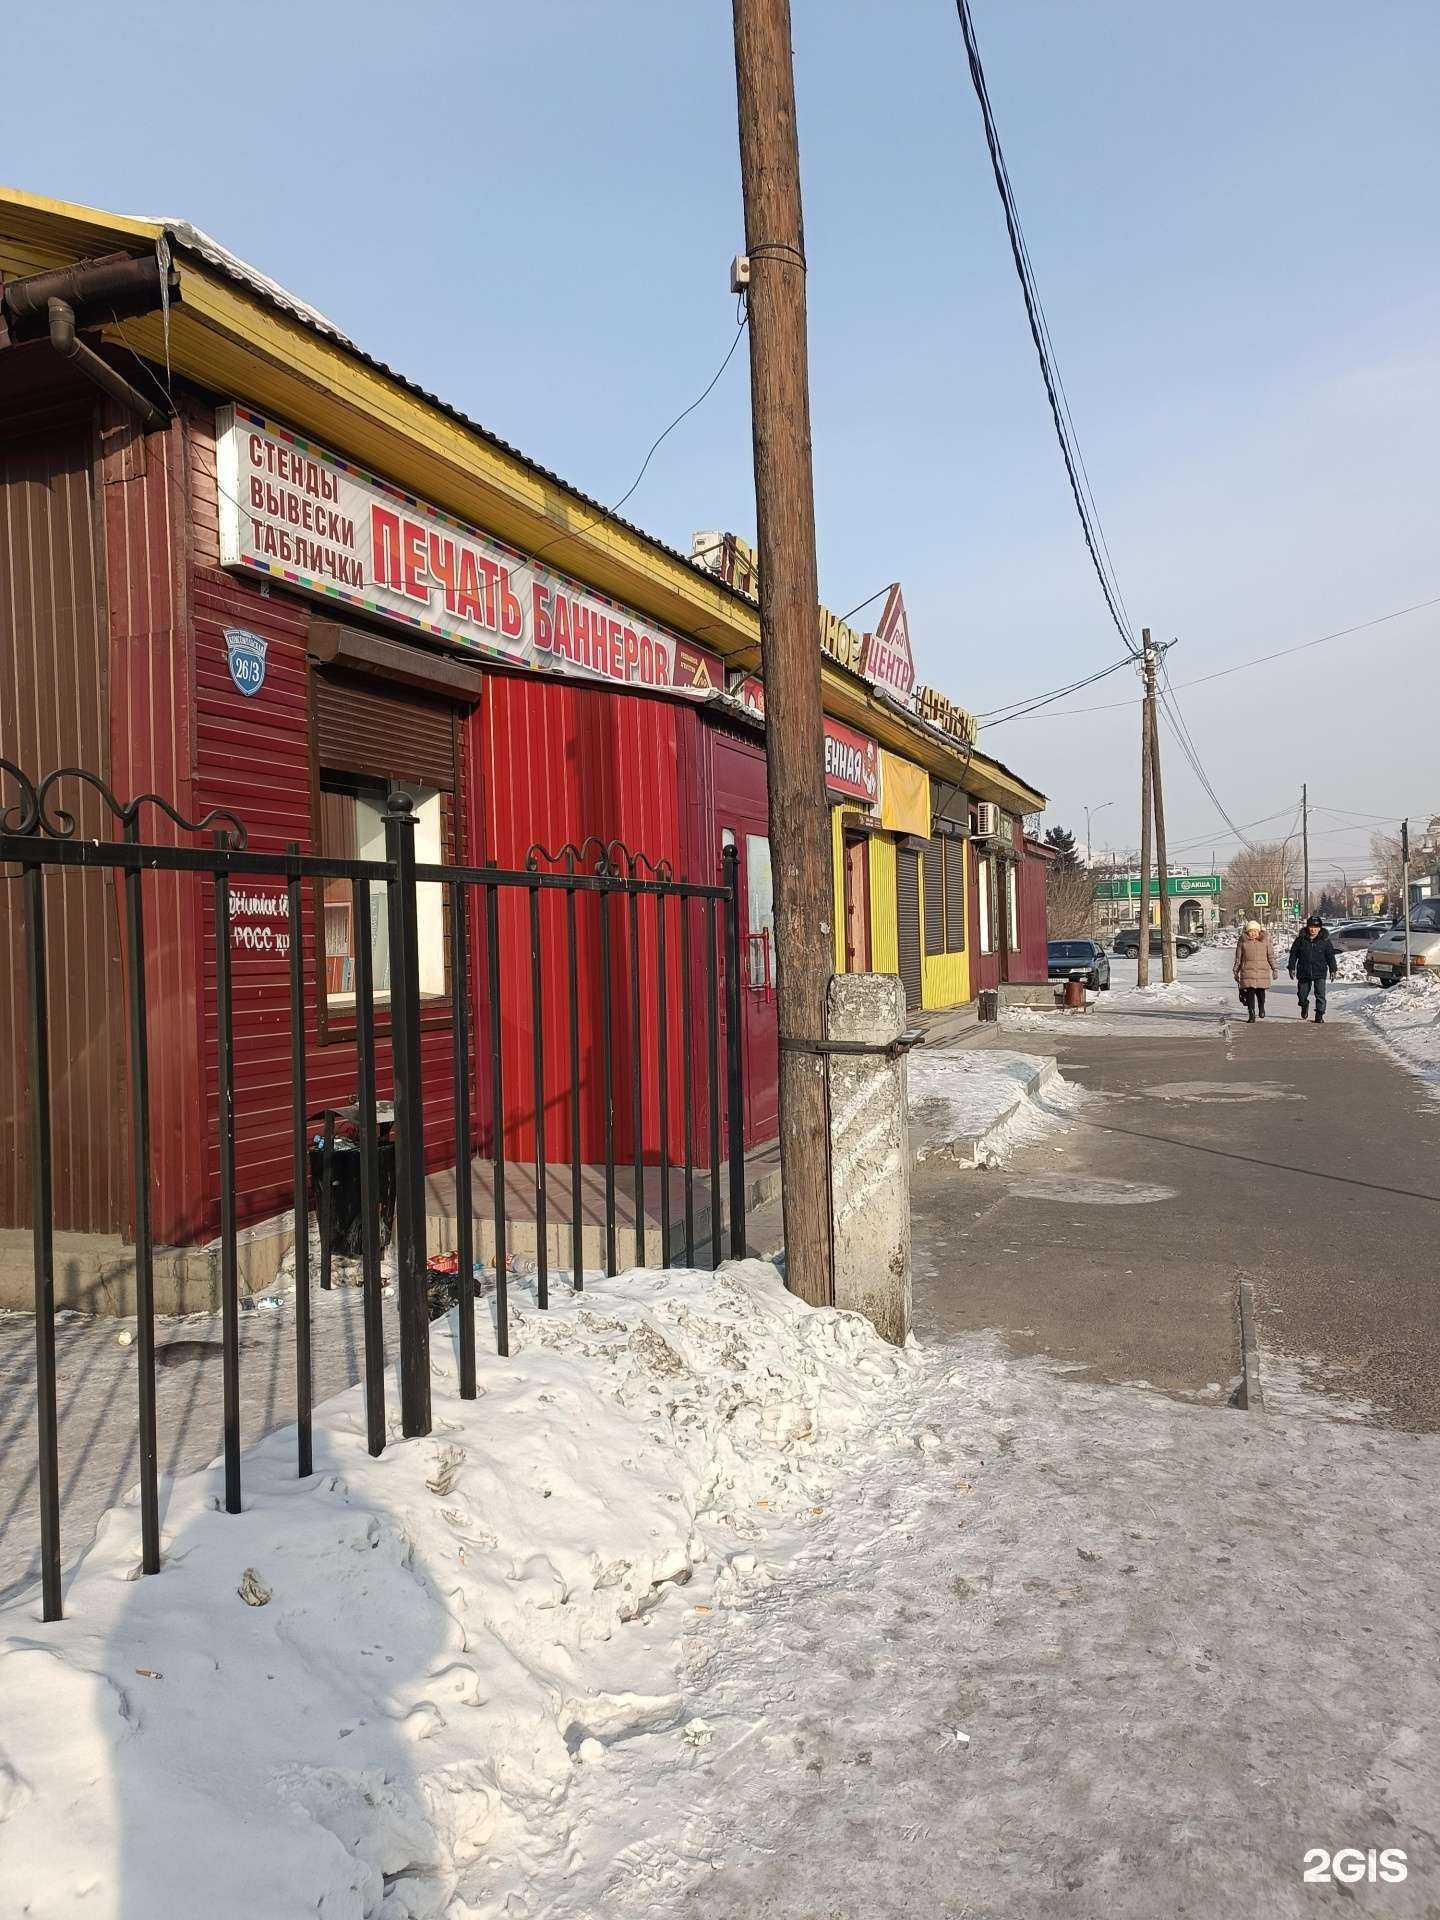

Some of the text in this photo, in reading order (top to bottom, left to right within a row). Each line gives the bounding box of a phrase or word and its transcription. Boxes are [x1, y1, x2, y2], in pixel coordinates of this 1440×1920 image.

[249, 433, 339, 503] СТЕНДЫ
[250, 474, 354, 550] ВЫВЕСКИ
[250, 517, 364, 590] ТАБЛИЧКИ
[371, 502, 522, 640] ПЕЧАТЬ
[235, 657, 260, 682] 26/3
[867, 638, 911, 693] ЦЕНТР
[824, 736, 862, 785] ЕННАЯ
